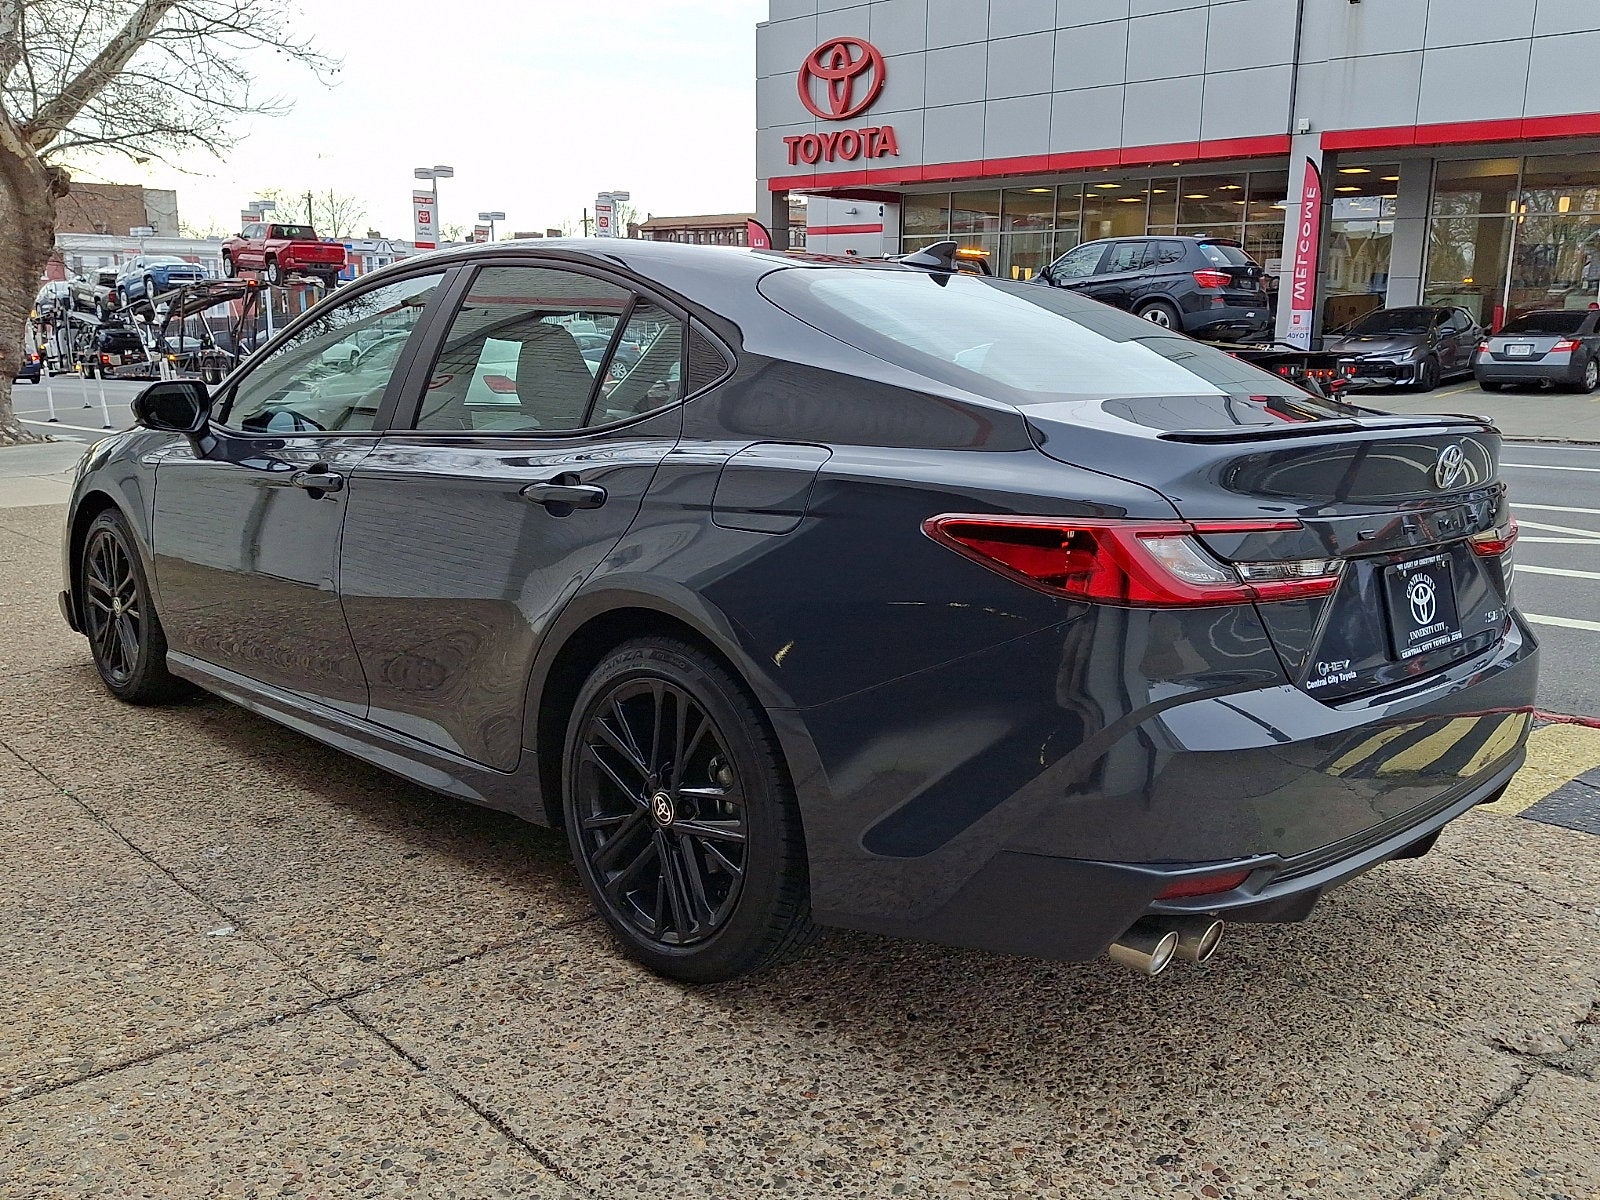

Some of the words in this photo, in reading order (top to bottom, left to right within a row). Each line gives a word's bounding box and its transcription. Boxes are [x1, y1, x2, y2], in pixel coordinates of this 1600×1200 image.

[783, 126, 899, 165] TOYOTA
[1406, 573, 1423, 599] CENTRAL
[1423, 573, 1437, 592] CITY
[1409, 624, 1434, 641] UNIVERSITY
[1434, 621, 1446, 633] CITY
[1401, 646, 1422, 659] CENTRAL
[1422, 642, 1433, 652] CITY
[1306, 677, 1328, 690] Central
[1327, 674, 1339, 684] City
[1339, 670, 1358, 682] Toyota
